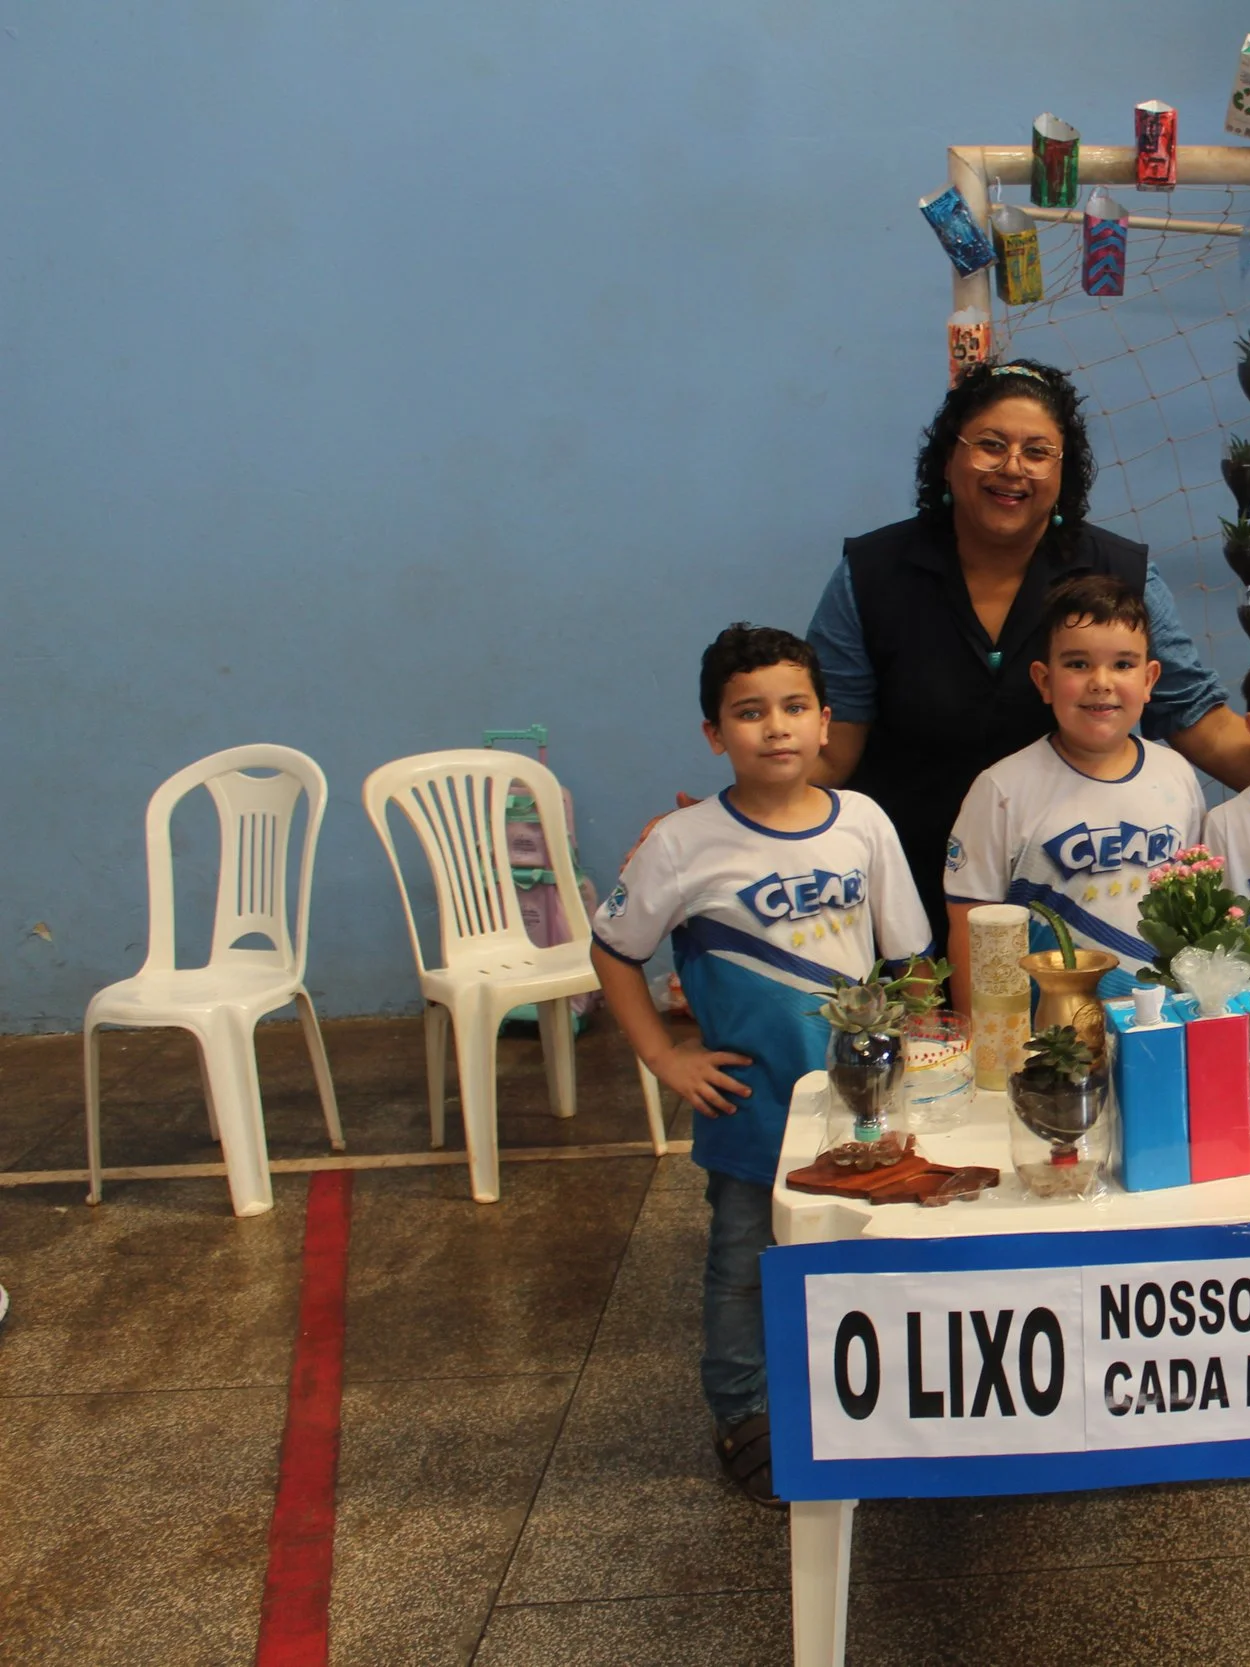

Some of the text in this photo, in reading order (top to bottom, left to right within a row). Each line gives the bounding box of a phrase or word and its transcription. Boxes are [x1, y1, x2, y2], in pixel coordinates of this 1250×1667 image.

[834, 1306, 1065, 1420] O LIXO
[1104, 1355, 1230, 1416] CADA
